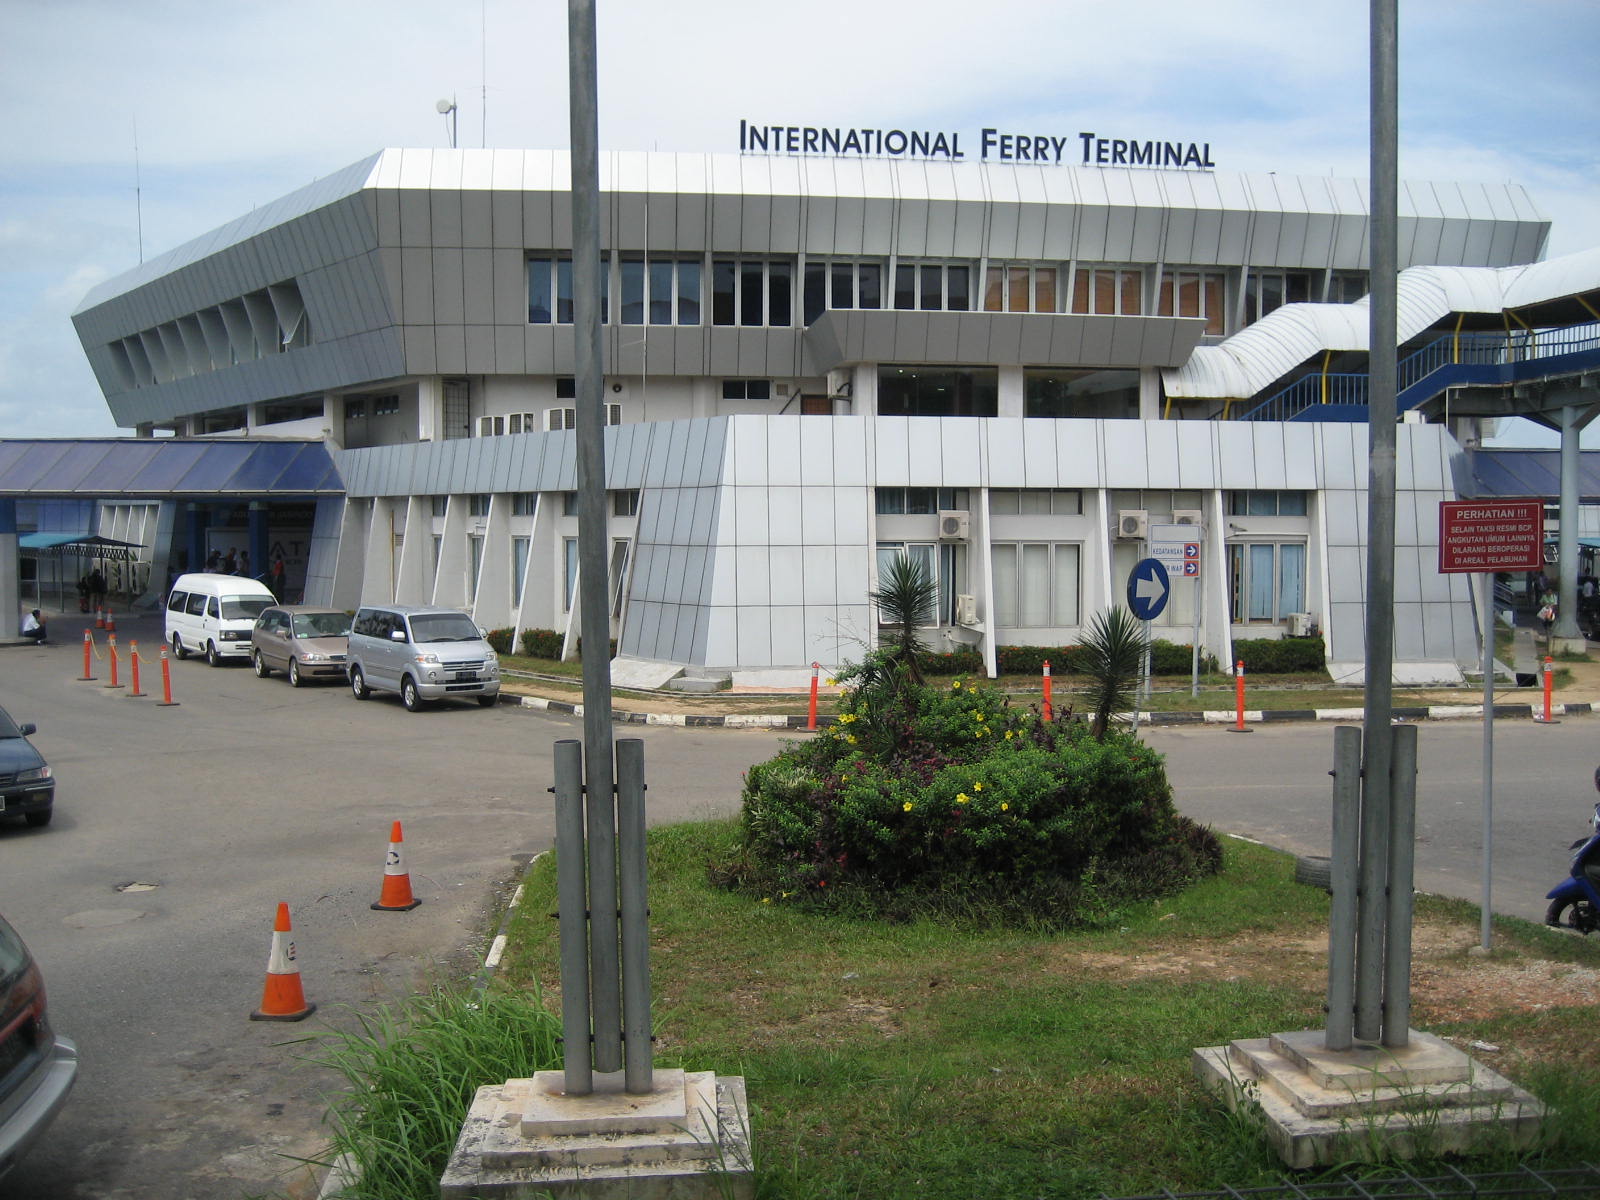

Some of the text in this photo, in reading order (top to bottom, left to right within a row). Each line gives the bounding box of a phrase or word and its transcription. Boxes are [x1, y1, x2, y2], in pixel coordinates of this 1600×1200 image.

[981, 128, 1067, 162] FERRY
[1080, 132, 1215, 168] TERMINAL
[1456, 510, 1515, 519] PERHATIAN
[1450, 525, 1475, 534] SELAIN
[1476, 525, 1495, 533] TAKSI
[1496, 524, 1517, 532] RESMI
[1447, 534, 1535, 544] ANGKUTAN UMUM LAINNYA
[1452, 545, 1530, 554] DILARANG BEROPERASI
[1454, 555, 1528, 565] DI AREAL PELABUHAN
